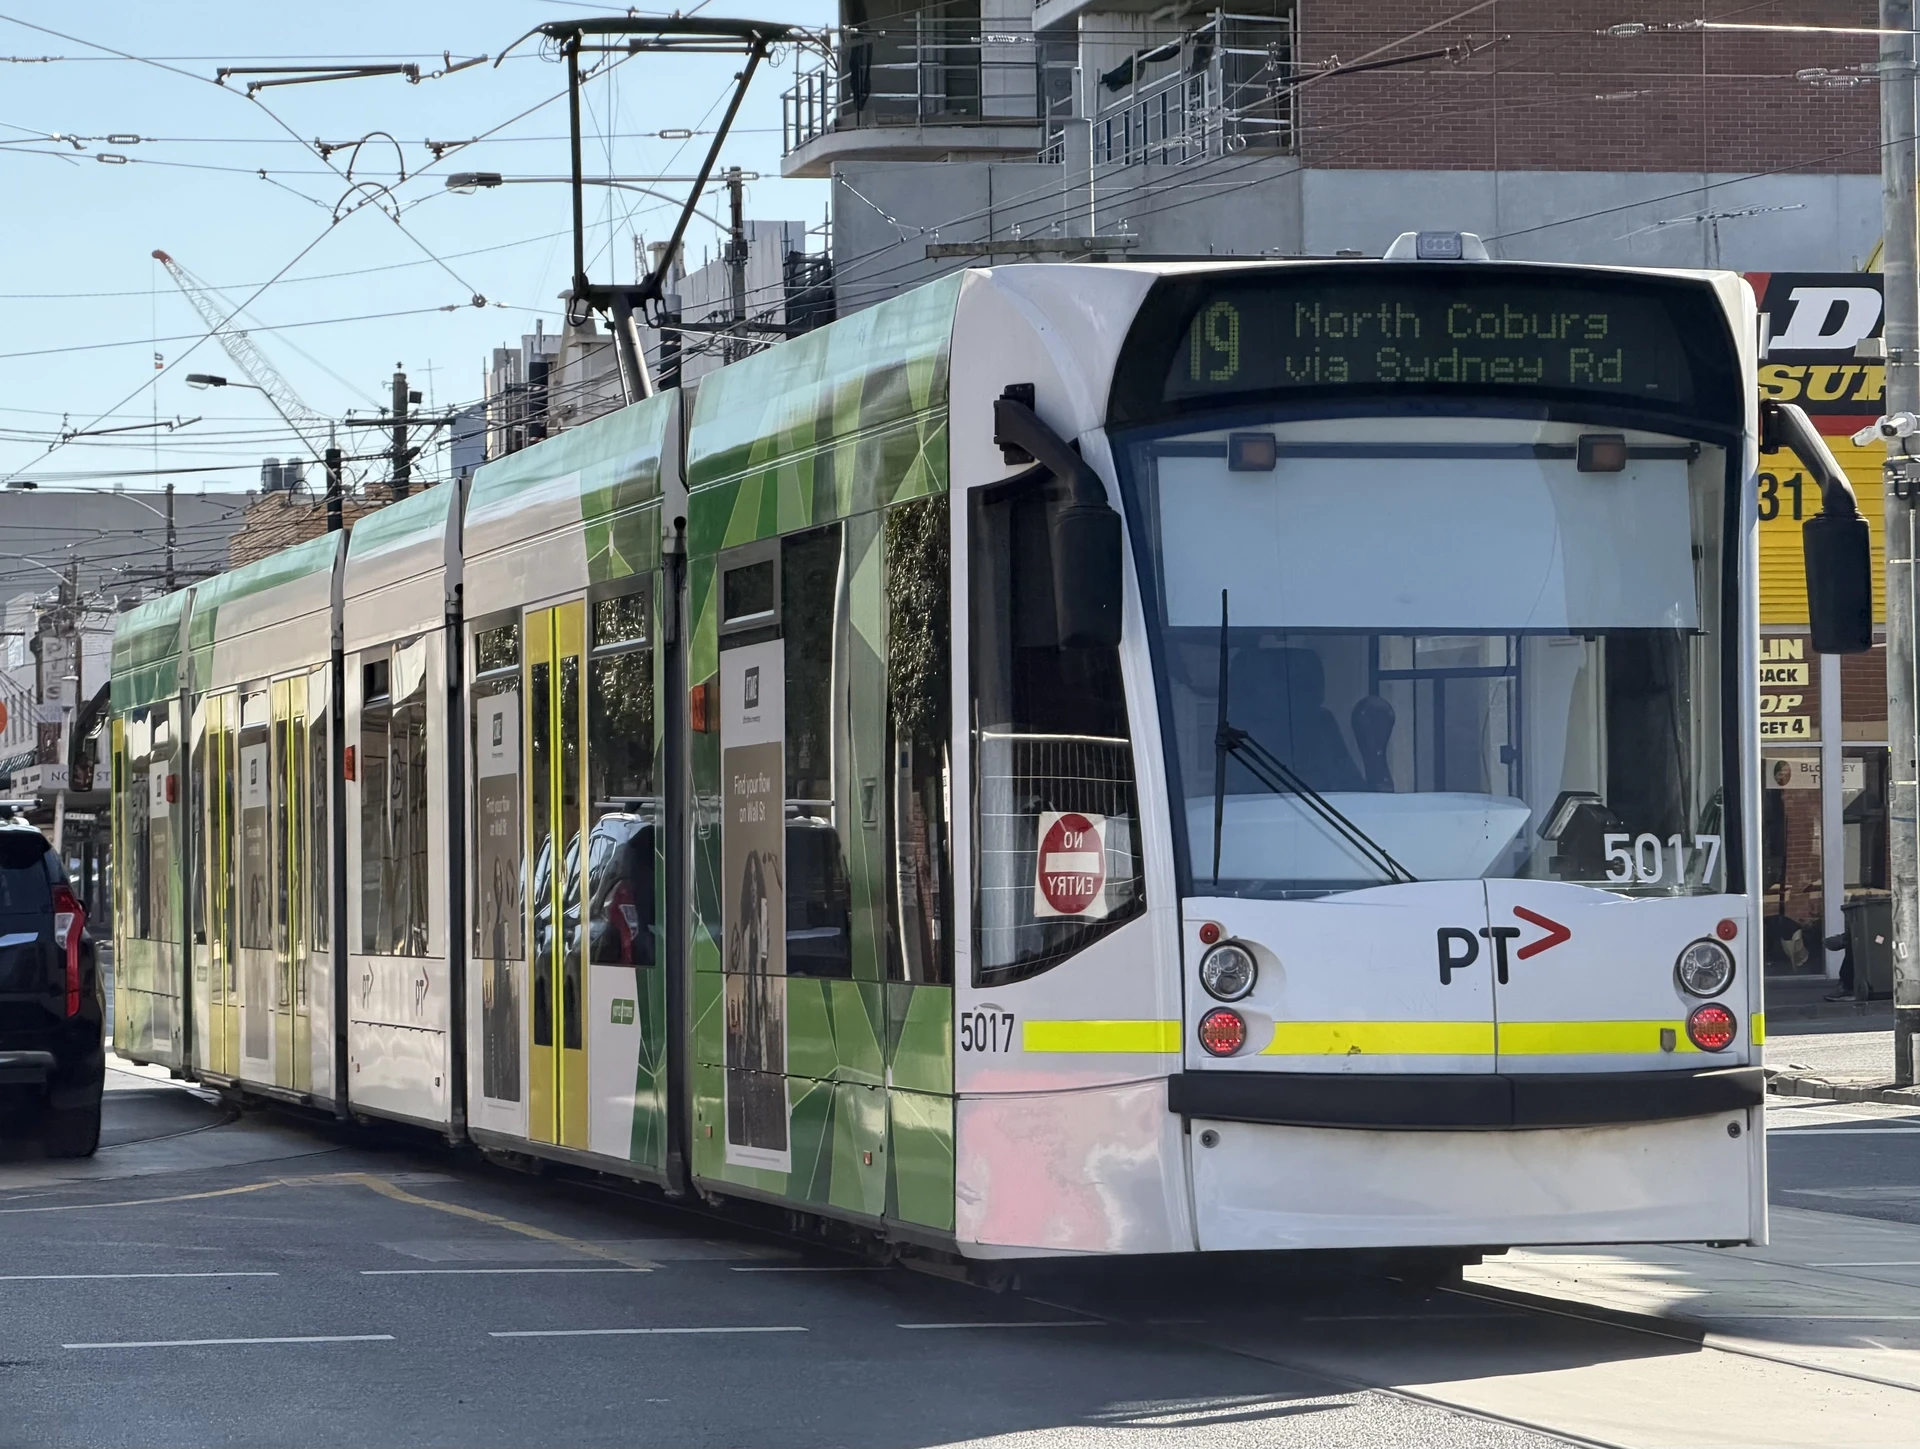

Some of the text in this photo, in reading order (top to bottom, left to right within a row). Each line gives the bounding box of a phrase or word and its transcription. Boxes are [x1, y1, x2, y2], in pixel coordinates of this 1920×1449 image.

[1295, 302, 1608, 340] North Coburg
[1189, 301, 1240, 381] 19
[1284, 347, 1623, 384] via Sydney Rd
[1760, 718, 1804, 734] GET 4
[1603, 832, 1722, 886] 5017
[960, 1012, 1015, 1053] 5017
